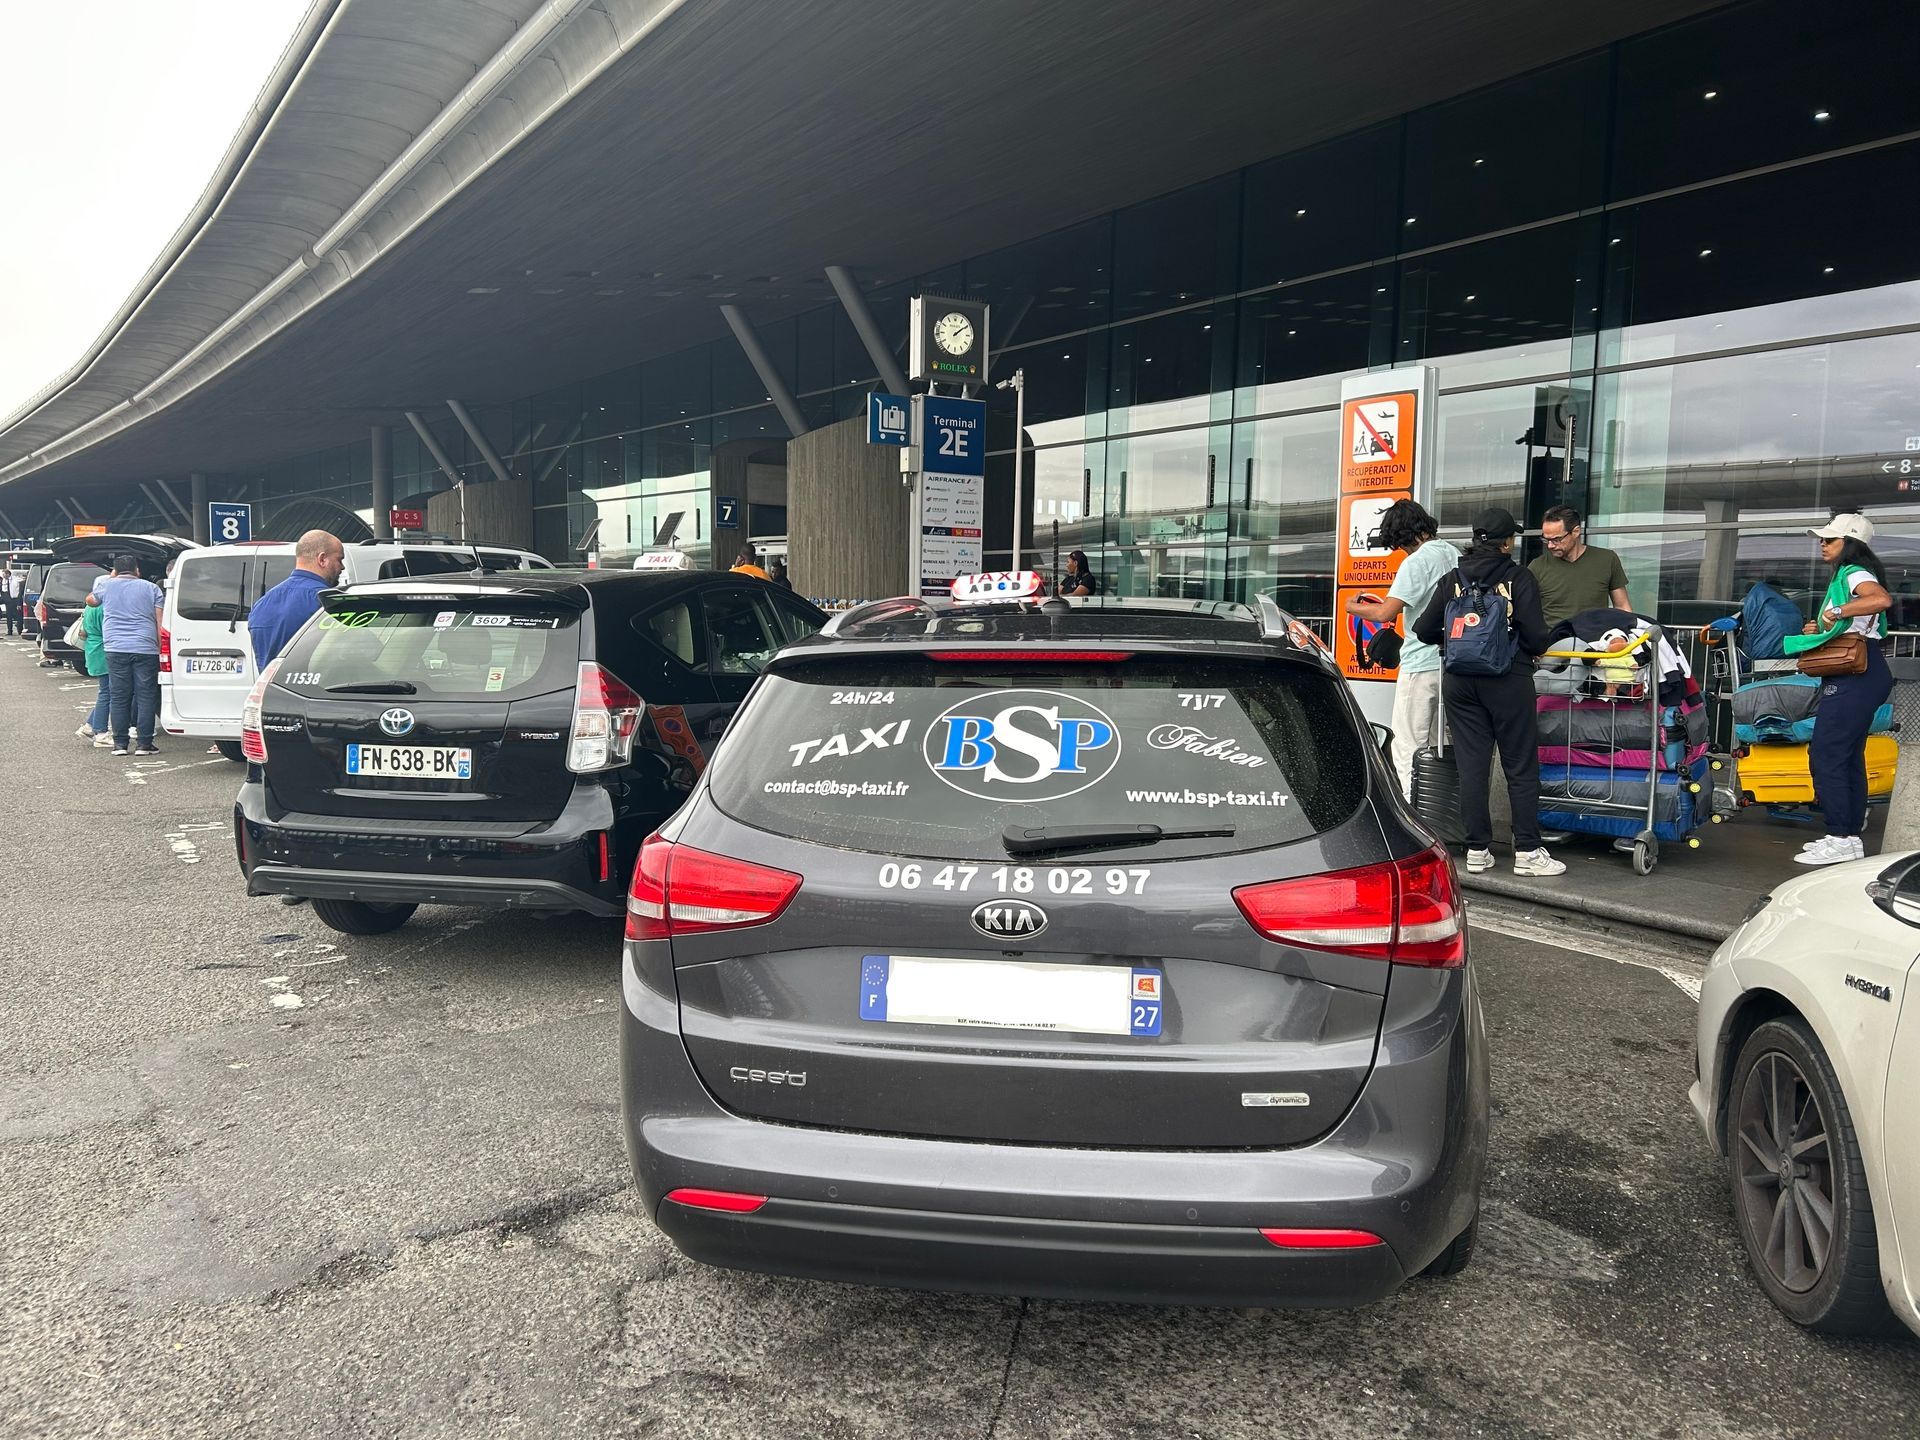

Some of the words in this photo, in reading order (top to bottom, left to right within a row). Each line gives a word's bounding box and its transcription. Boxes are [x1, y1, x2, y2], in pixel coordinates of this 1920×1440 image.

[940, 362, 968, 373] ROLEX
[933, 415, 976, 429] Terminal
[939, 428, 969, 457] 2E
[1900, 459, 1911, 473] 8
[1354, 476, 1394, 487] INTERDITE
[722, 506, 732, 520] 7
[222, 517, 239, 539] 8
[648, 555, 674, 563] TAXI
[1353, 560, 1387, 570] DÉPARTS
[437, 615, 453, 623] G7
[475, 616, 506, 624] 3607
[285, 672, 321, 684] 11538
[829, 691, 895, 705] 24h/24
[1177, 693, 1226, 711] 7j/7
[520, 732, 554, 740] HYBRID
[788, 719, 911, 767] TAXI
[934, 705, 1113, 783] BSP
[1146, 723, 1268, 768] Fabien
[361, 748, 457, 772] FN-638-BK
[459, 762, 469, 774] 75
[763, 779, 910, 798] contact@bsp-taxi.fr
[1126, 789, 1289, 808] www.bsp-taxi.fr
[878, 863, 922, 890] 06
[932, 866, 979, 892] 47
[991, 866, 1034, 893] 18
[1047, 868, 1093, 895] 02
[1105, 869, 1151, 895] 97
[984, 908, 1035, 931] KIA
[1844, 973, 1883, 1000] HYBRID
[869, 994, 878, 1008] F
[1134, 1006, 1159, 1027] 27
[1269, 1096, 1308, 1105] dynamics
